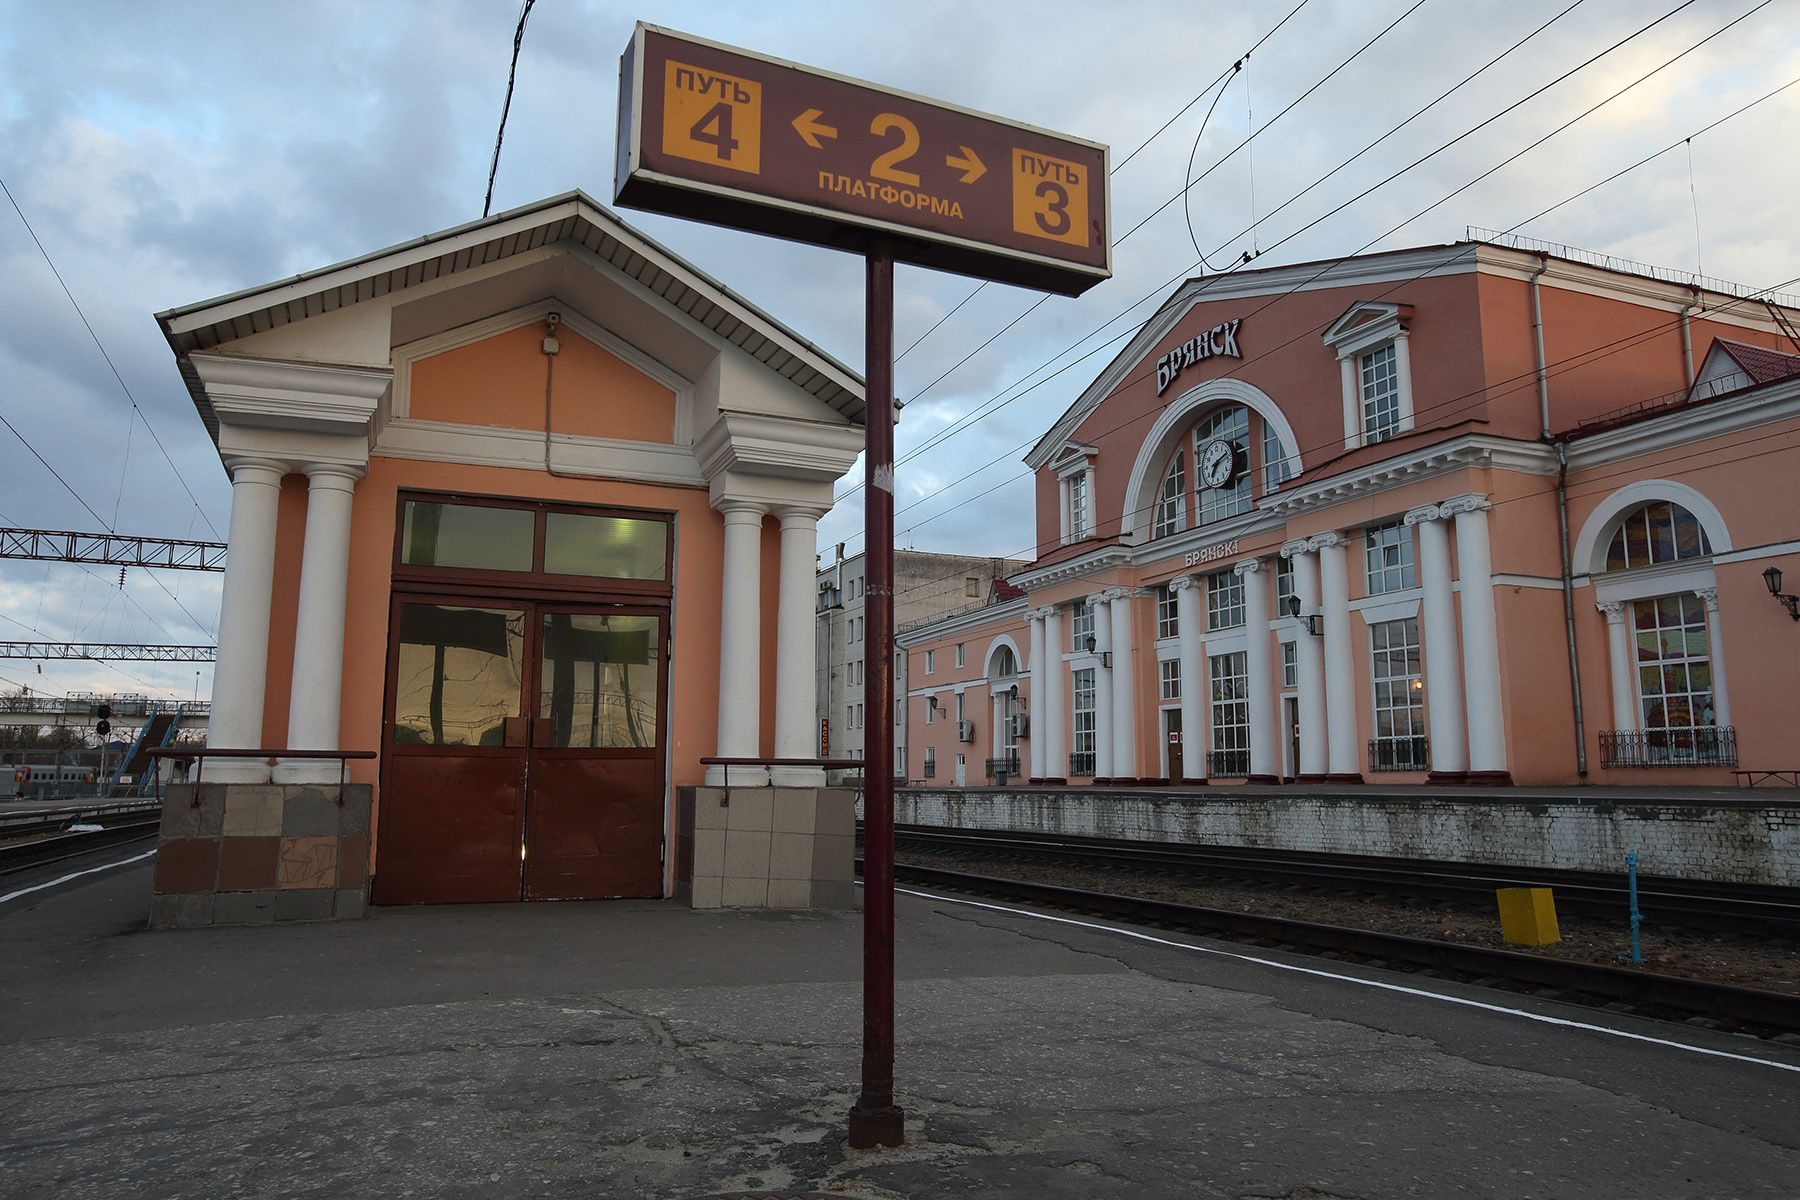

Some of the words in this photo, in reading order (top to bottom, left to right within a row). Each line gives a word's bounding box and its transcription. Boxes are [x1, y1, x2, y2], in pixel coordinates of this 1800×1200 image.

[676, 68, 751, 104] ПУТЬ
[690, 102, 739, 161] 4
[870, 113, 920, 188] 2
[819, 171, 964, 220] ПЛАТФОРМА
[1021, 155, 1080, 185] ПУТЬ
[1034, 181, 1071, 236] 3
[1157, 318, 1242, 397] БРЯНСК
